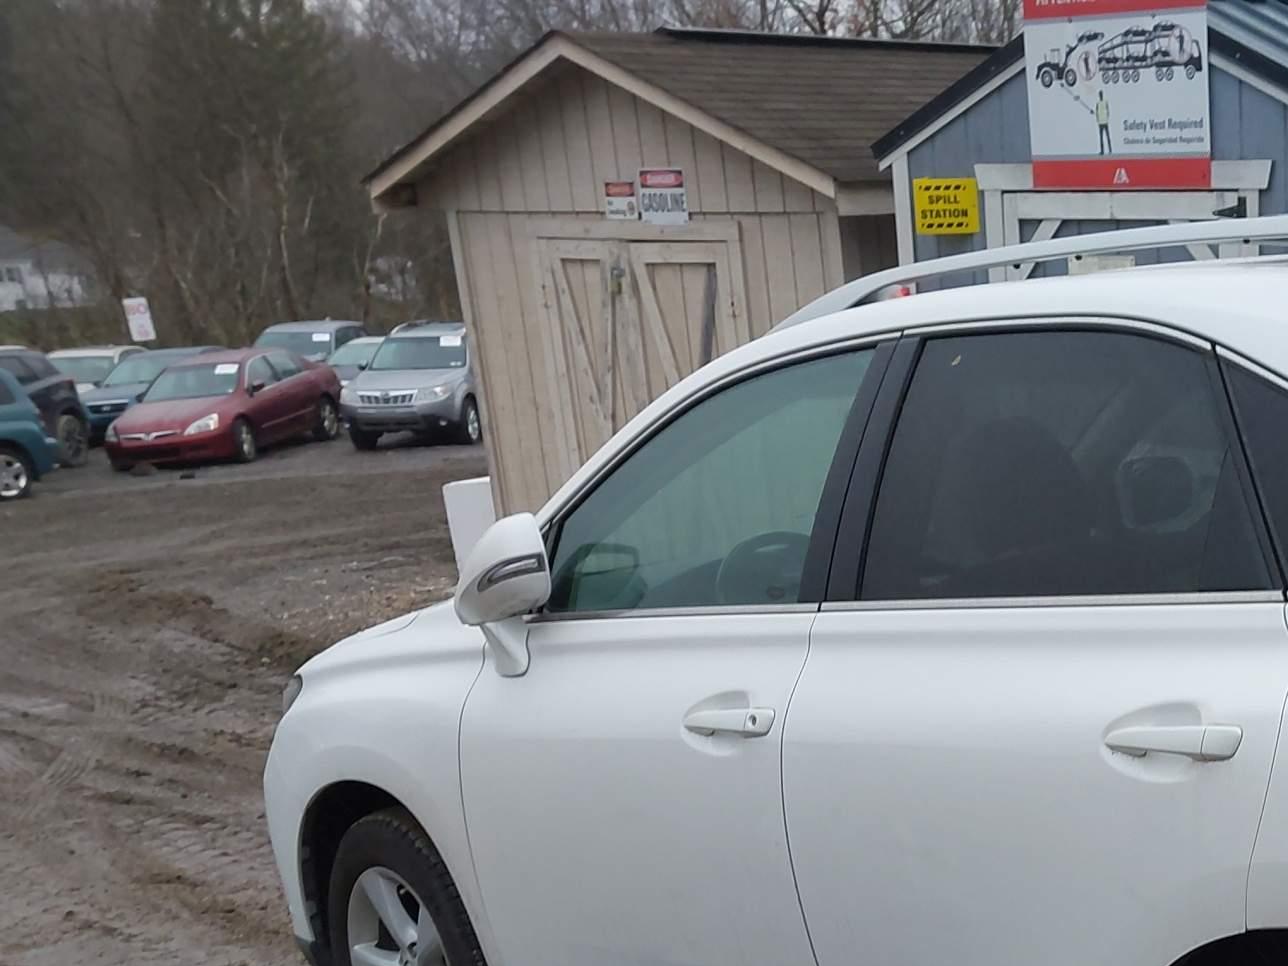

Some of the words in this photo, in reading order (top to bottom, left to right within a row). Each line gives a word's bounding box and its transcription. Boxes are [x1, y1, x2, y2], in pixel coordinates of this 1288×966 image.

[1123, 119, 1147, 133] Safety
[1149, 119, 1166, 130] Vest
[1168, 117, 1204, 132] Required
[642, 192, 687, 212] GASOLINE
[928, 195, 960, 205] SPILL
[921, 208, 968, 220] STATION
